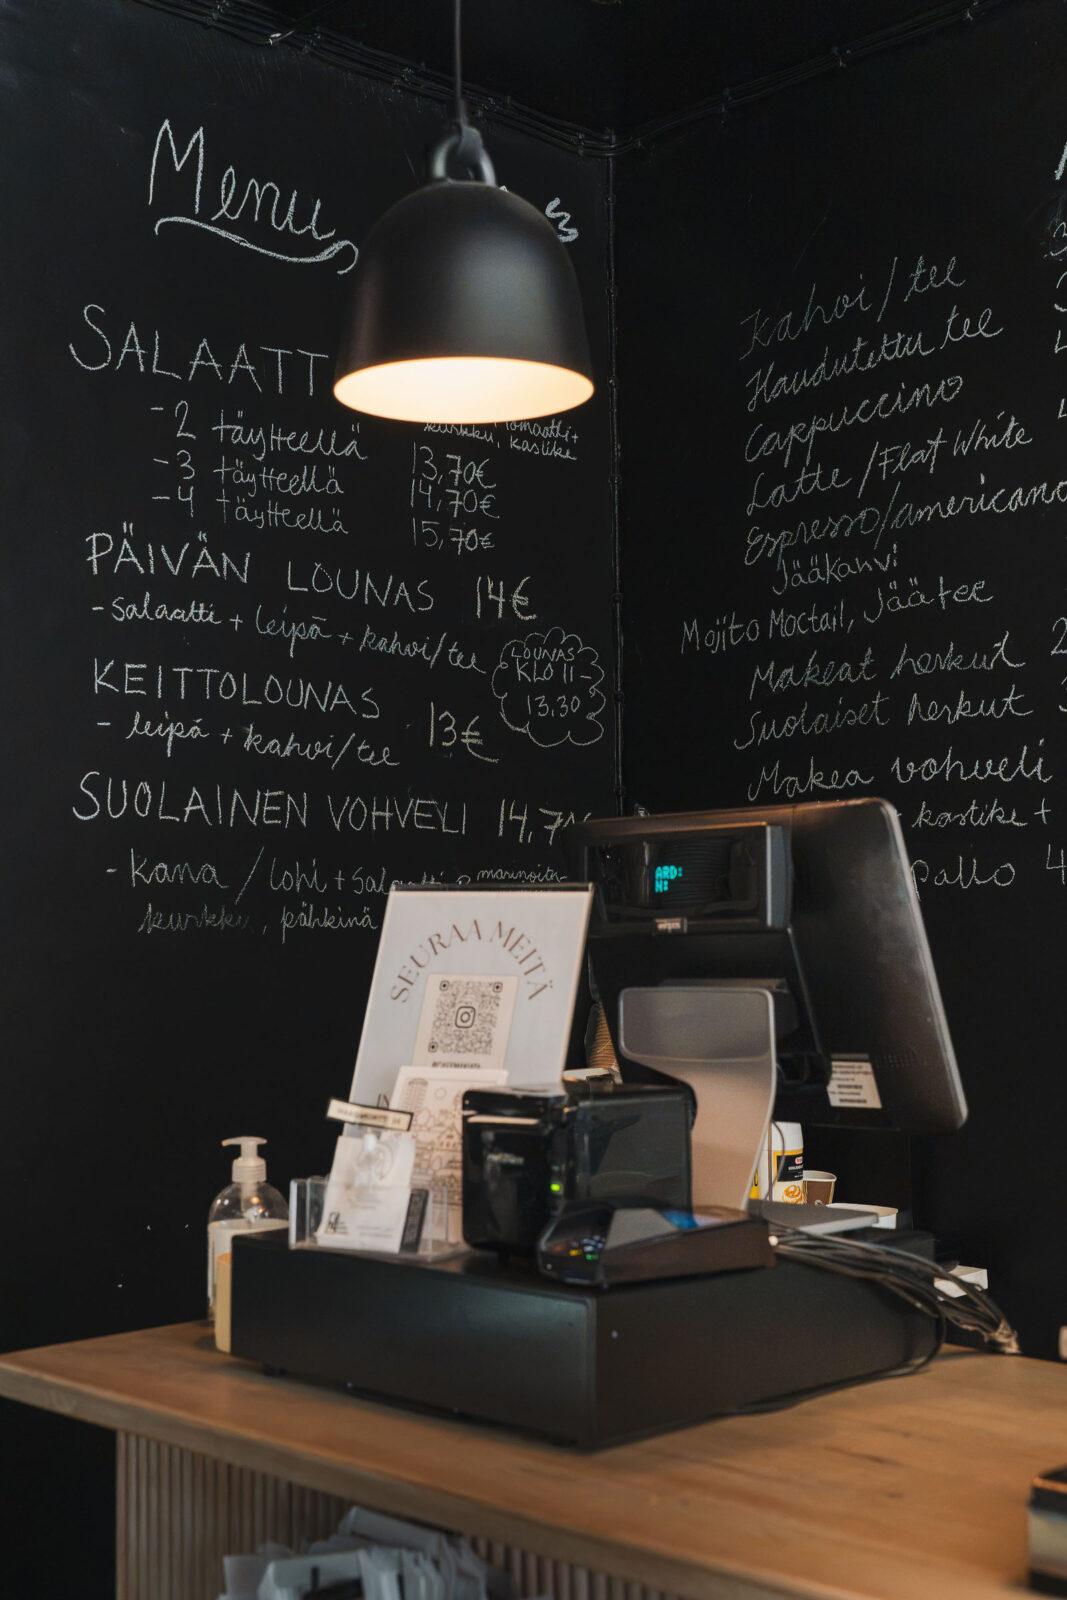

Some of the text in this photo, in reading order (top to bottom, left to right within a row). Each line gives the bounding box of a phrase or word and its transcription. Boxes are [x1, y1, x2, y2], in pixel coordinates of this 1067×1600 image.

[149, 118, 335, 240] Menu
[904, 256, 967, 302] tee
[69, 304, 329, 395] SALAATT
[746, 304, 1003, 412] Haudutettu tee
[174, 400, 196, 440] 2
[211, 409, 368, 461] täytteellä
[744, 375, 963, 468] Cappuccino
[176, 450, 196, 480] 3
[213, 456, 344, 497] täytteellä
[412, 442, 496, 488] 13,70€
[746, 463, 853, 516] Latte
[953, 411, 1033, 456] White
[177, 485, 195, 518] 4
[216, 489, 348, 533] täytteellä
[411, 479, 499, 518] 14,70€
[412, 517, 495, 555] 15,70€
[85, 521, 537, 620] PÄIVÄN LOUNAS 14€
[111, 591, 222, 624] Salaatti
[681, 612, 760, 654] Mojito
[511, 647, 575, 662] LOUNAS
[517, 657, 553, 682] KLO
[749, 630, 1026, 700] Makeat herkut
[94, 657, 380, 718] KEITTOLOUNAS
[734, 690, 890, 750] Suolaiset
[907, 684, 1034, 725] herkut
[430, 701, 499, 763] 13€
[748, 738, 1053, 801] Makea vohveli
[72, 771, 591, 845] SUOLAINEN VOHVELI 14,7
[912, 798, 1028, 828] kastike
[390, 919, 553, 1003] SEURAA MEITÄ
